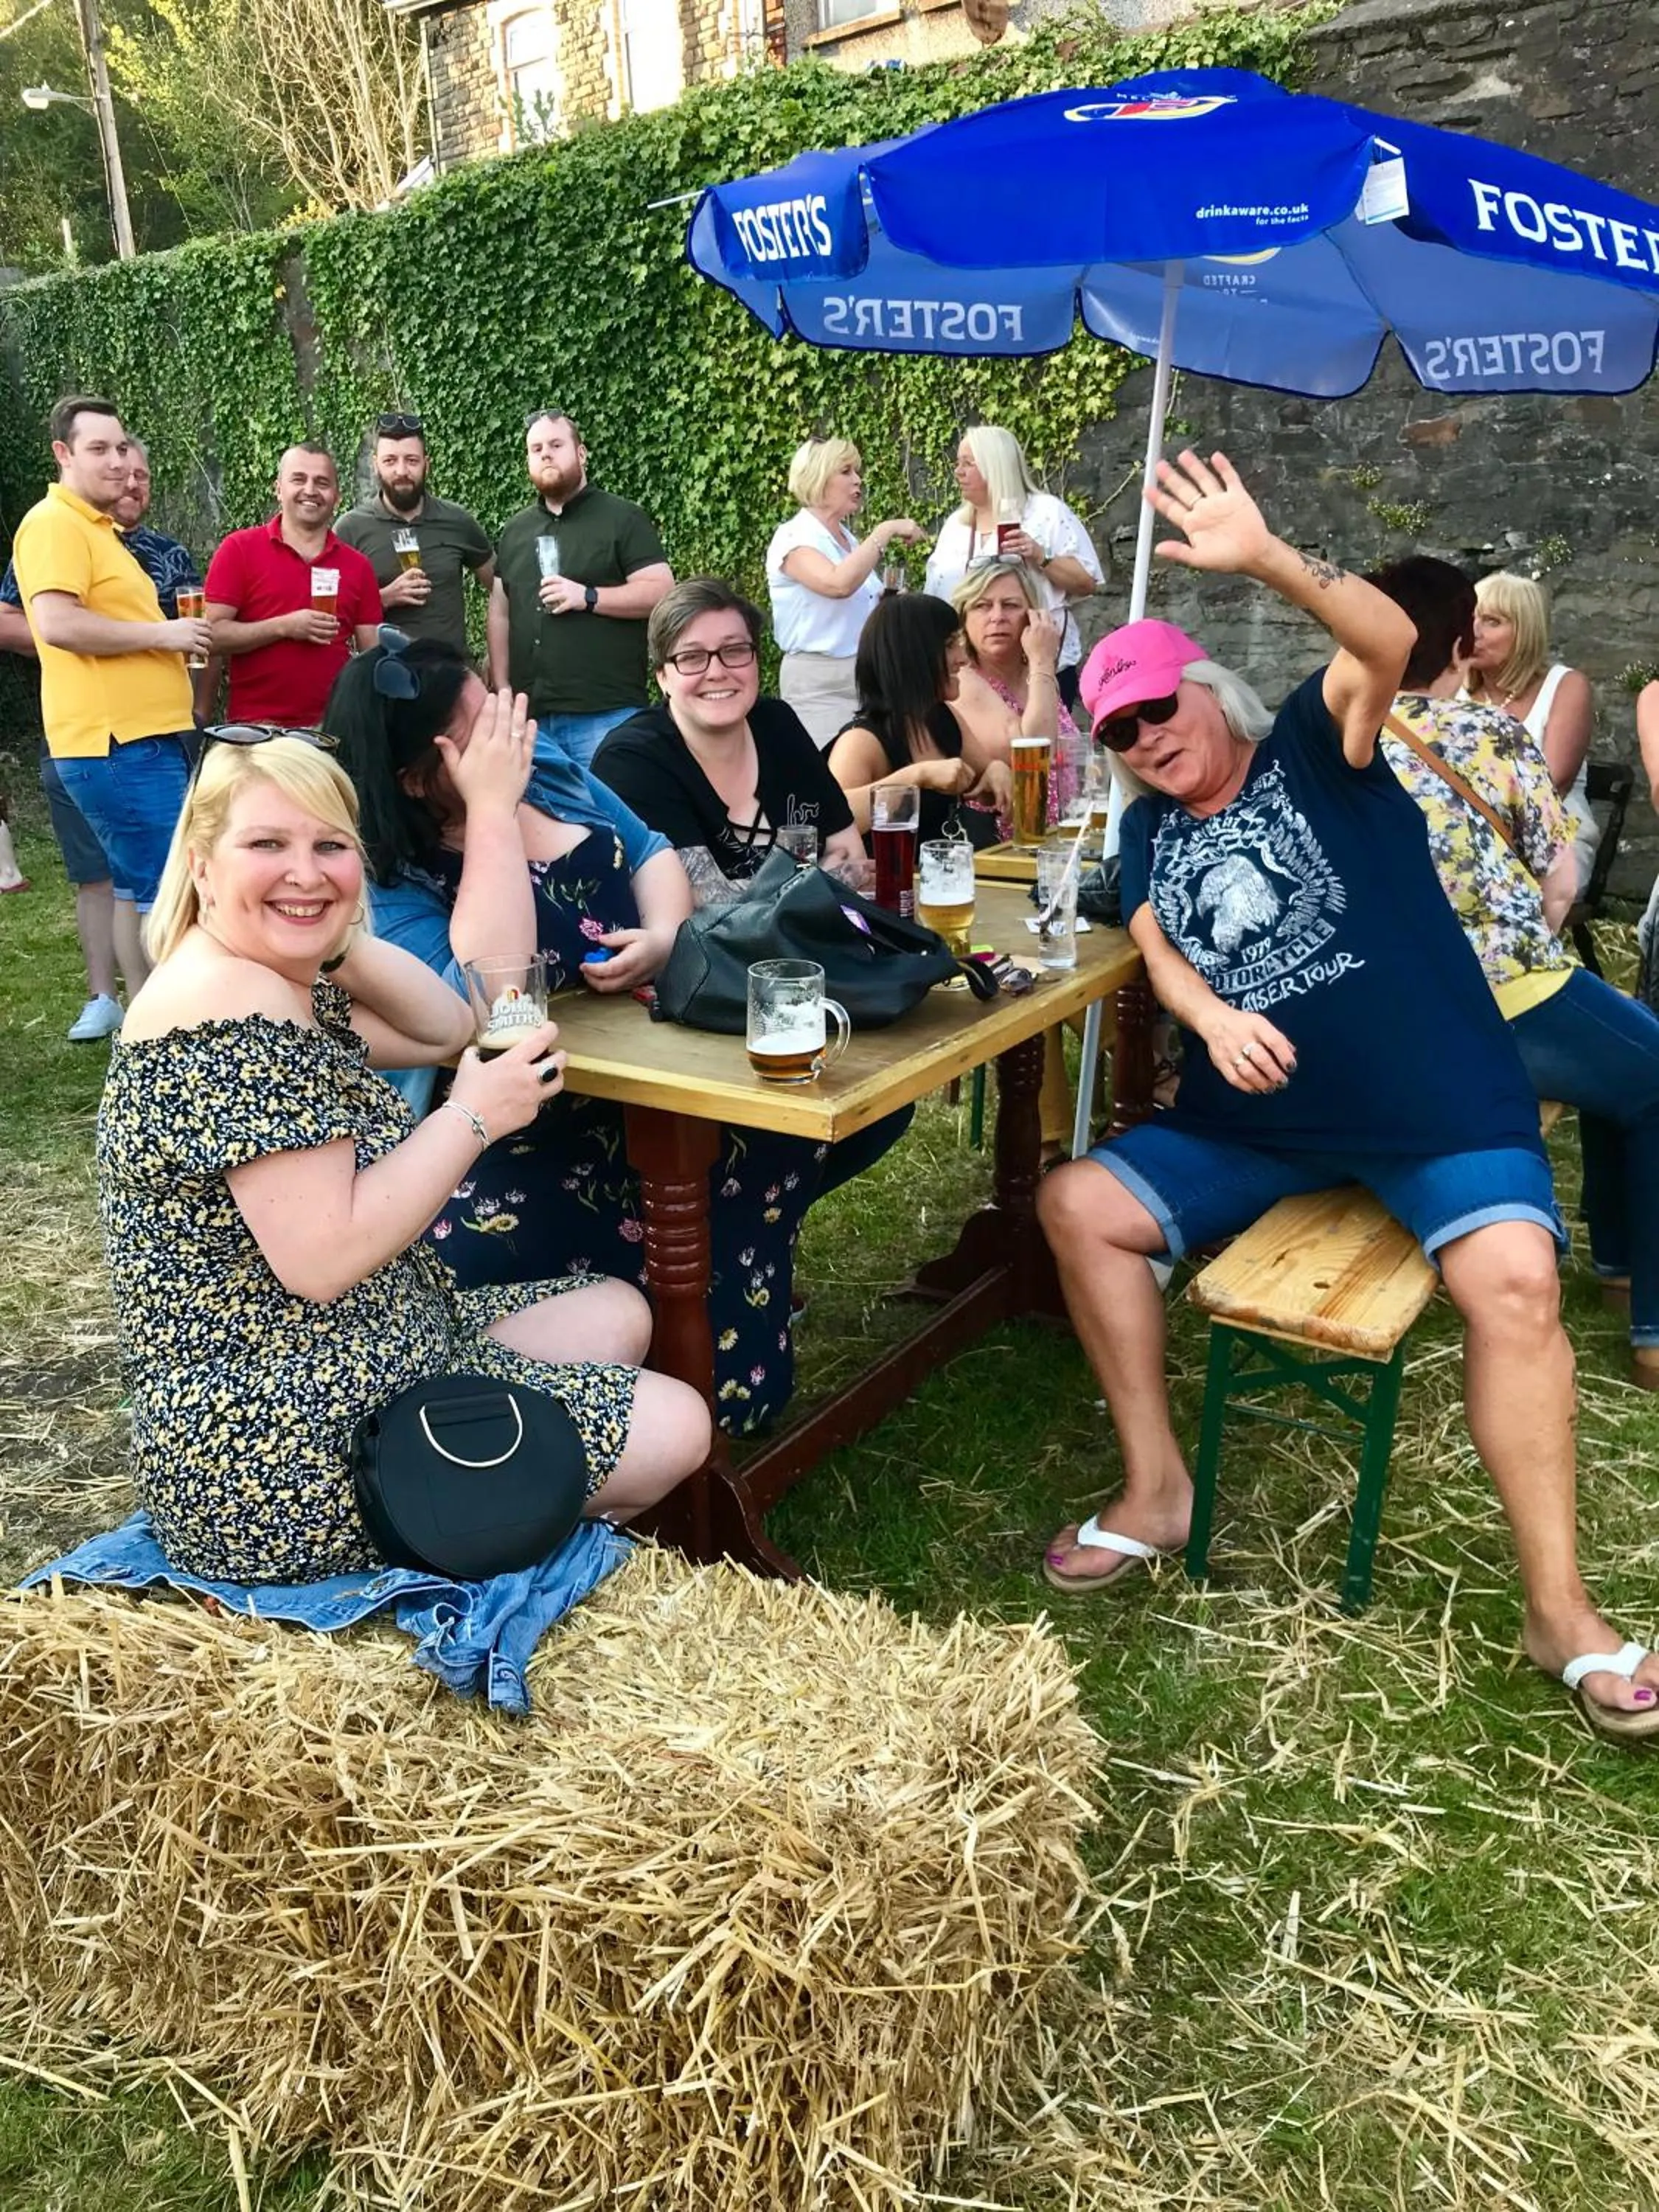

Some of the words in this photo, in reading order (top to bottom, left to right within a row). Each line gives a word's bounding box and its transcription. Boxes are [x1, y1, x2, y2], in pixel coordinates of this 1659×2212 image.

[1196, 203, 1309, 219] drinkaware.co.uk
[1256, 217, 1269, 225] for
[731, 193, 832, 262] FOSTER'S
[1297, 952, 1366, 989] TOUR
